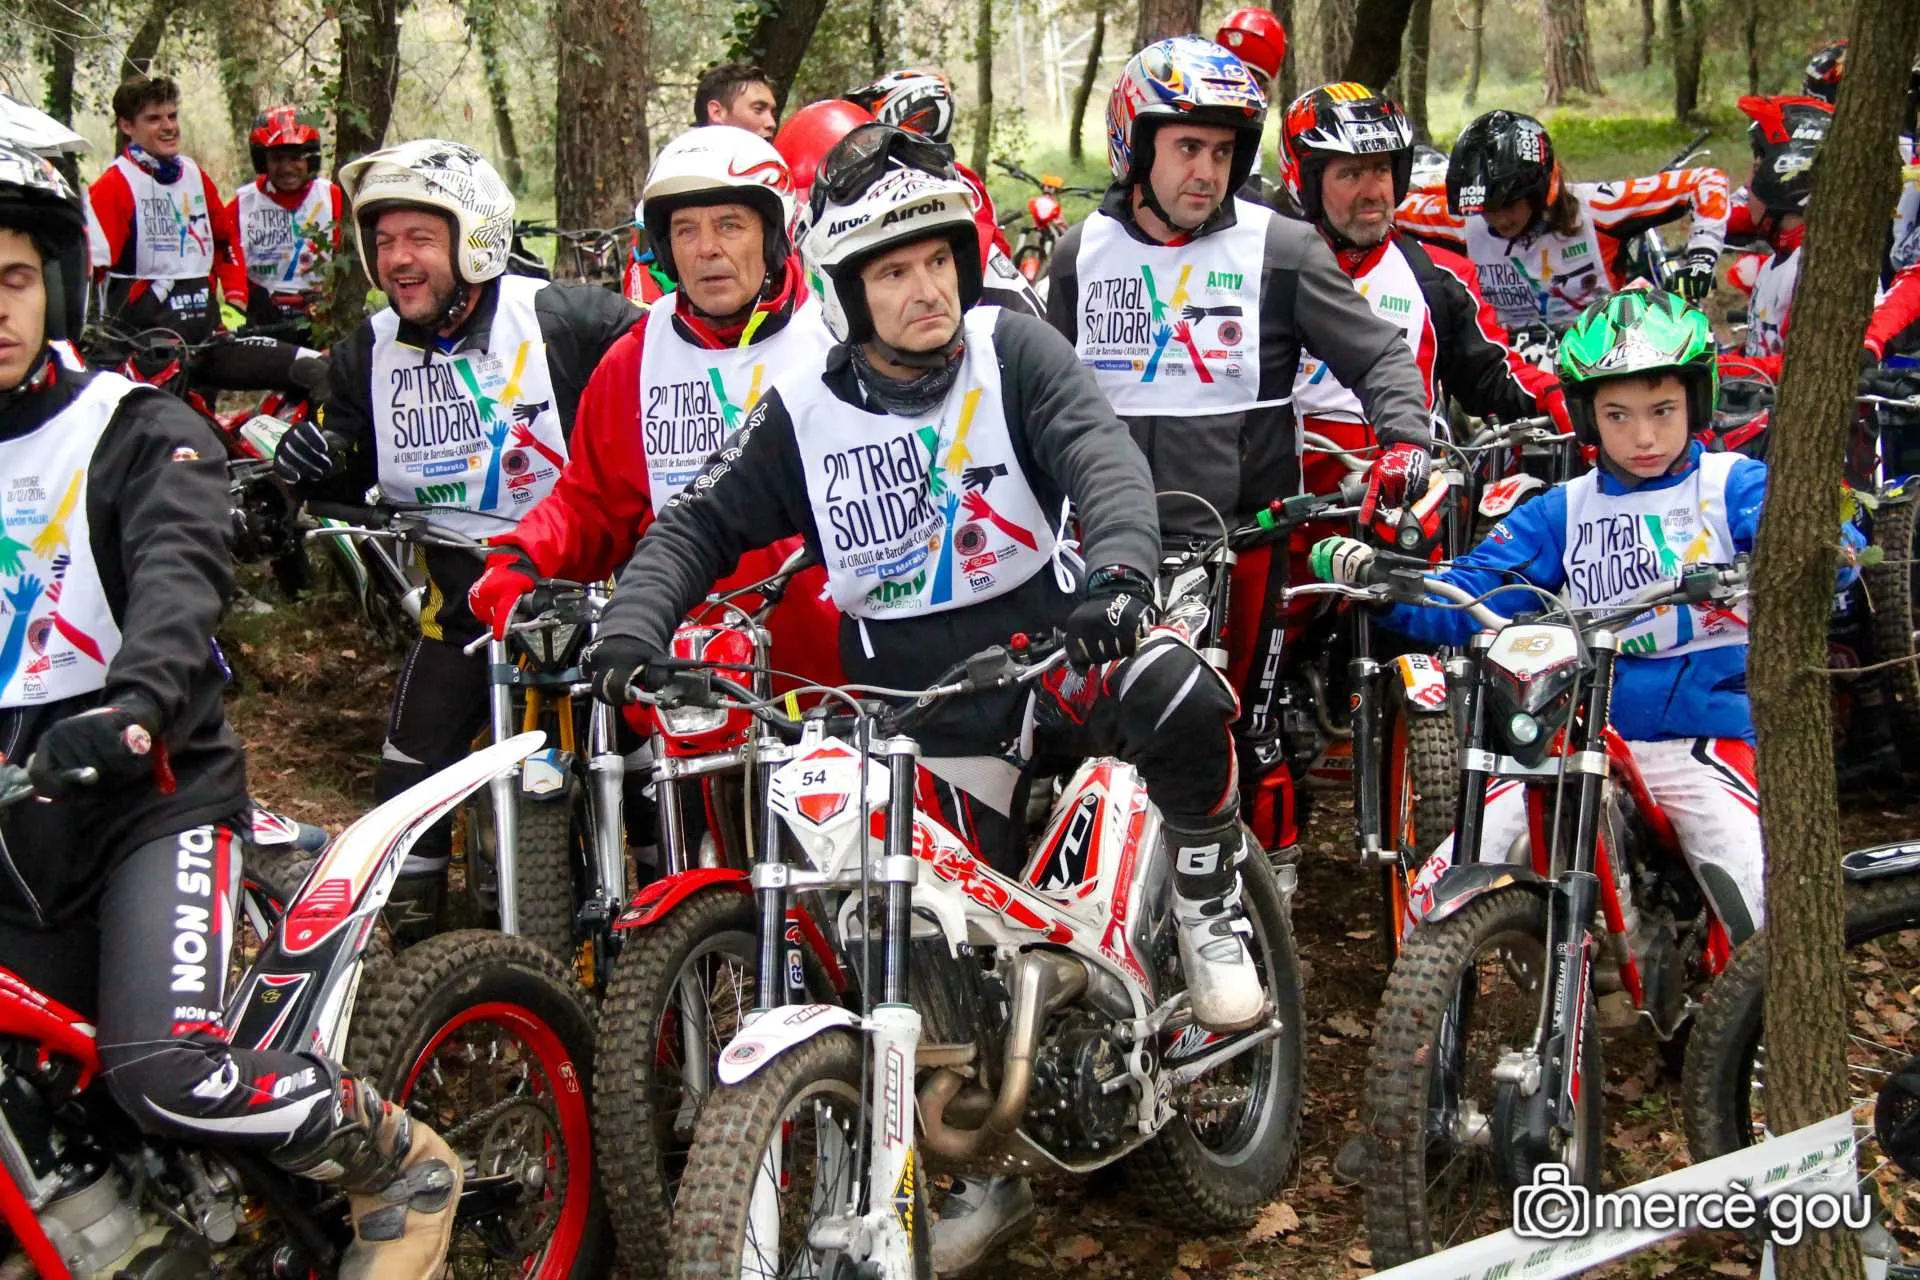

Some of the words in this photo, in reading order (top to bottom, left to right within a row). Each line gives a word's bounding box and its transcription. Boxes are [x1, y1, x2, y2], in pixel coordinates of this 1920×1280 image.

[1460, 186, 1486, 195] NON
[1459, 196, 1485, 206] STOP
[881, 199, 946, 228] Airoh
[802, 769, 827, 786] 54
[170, 904, 209, 992] NON
[175, 1006, 206, 1021] NON
